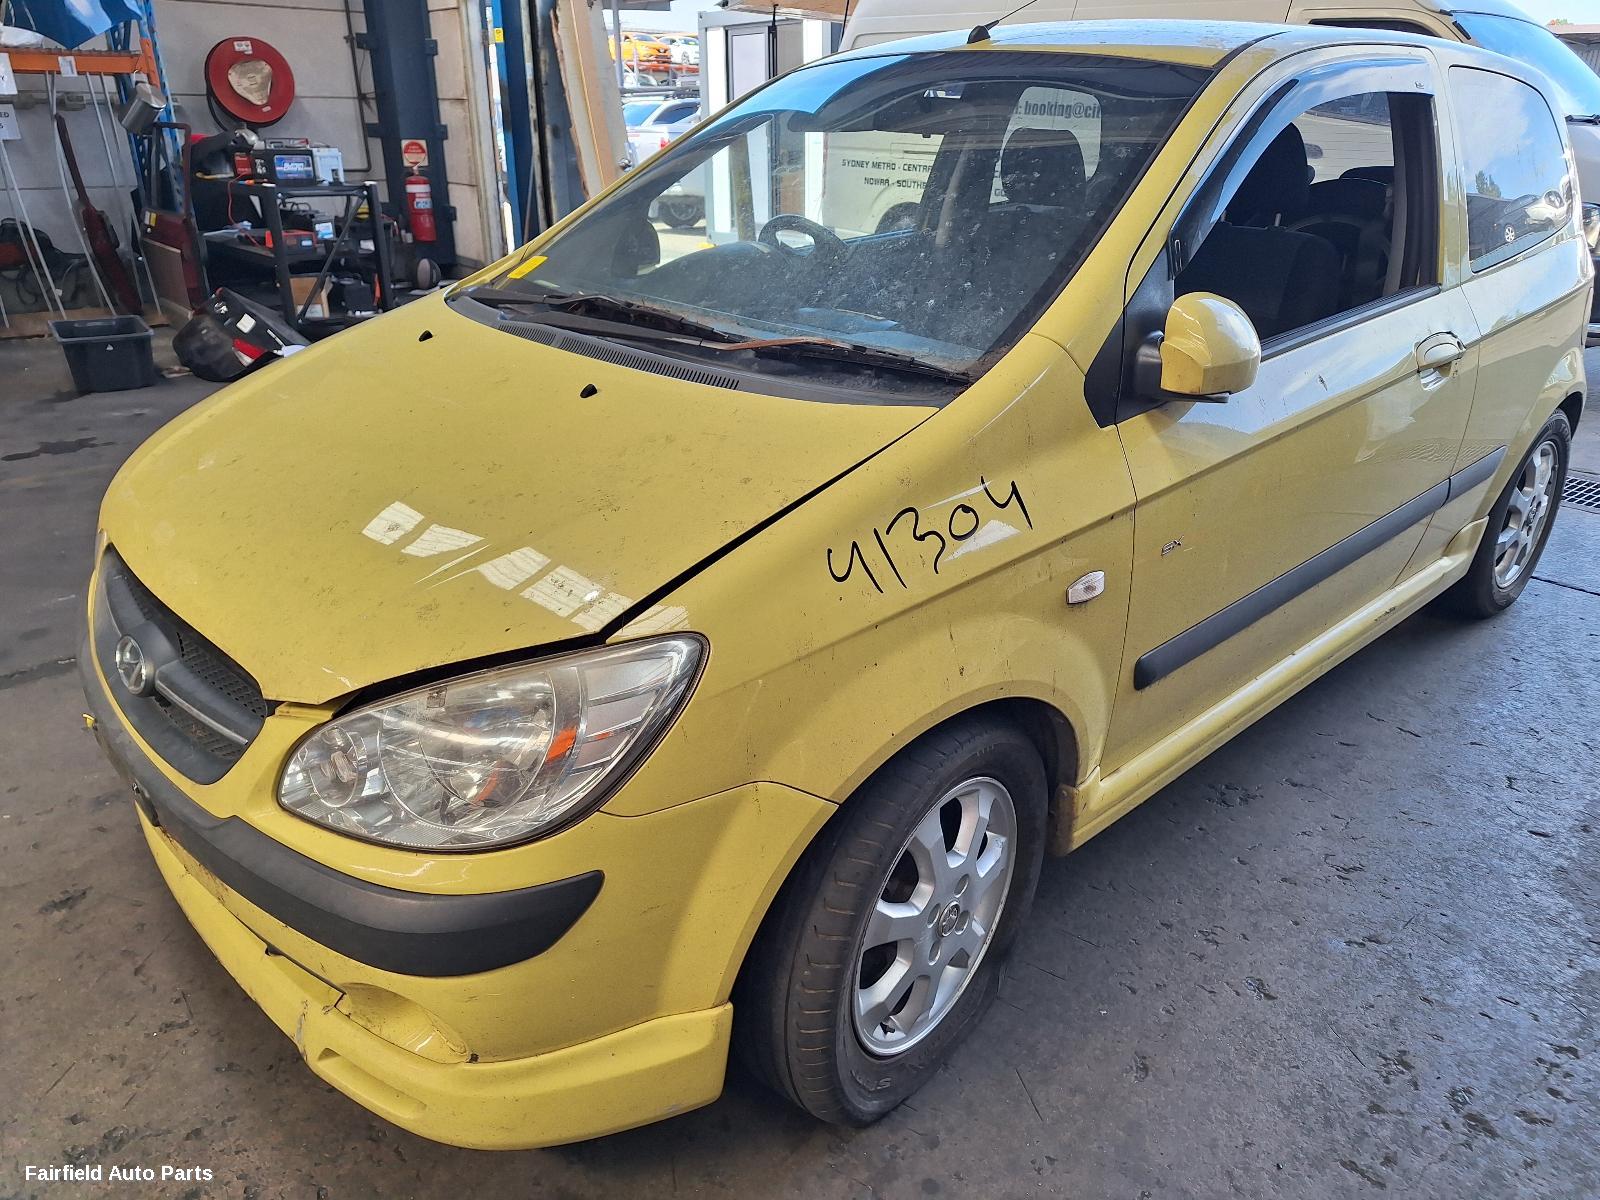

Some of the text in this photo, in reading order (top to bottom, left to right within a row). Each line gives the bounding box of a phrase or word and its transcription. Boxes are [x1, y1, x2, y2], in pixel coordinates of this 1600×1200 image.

[842, 159, 870, 169] SYDNEY
[871, 161, 896, 171] METRO
[827, 476, 1034, 594] 41304
